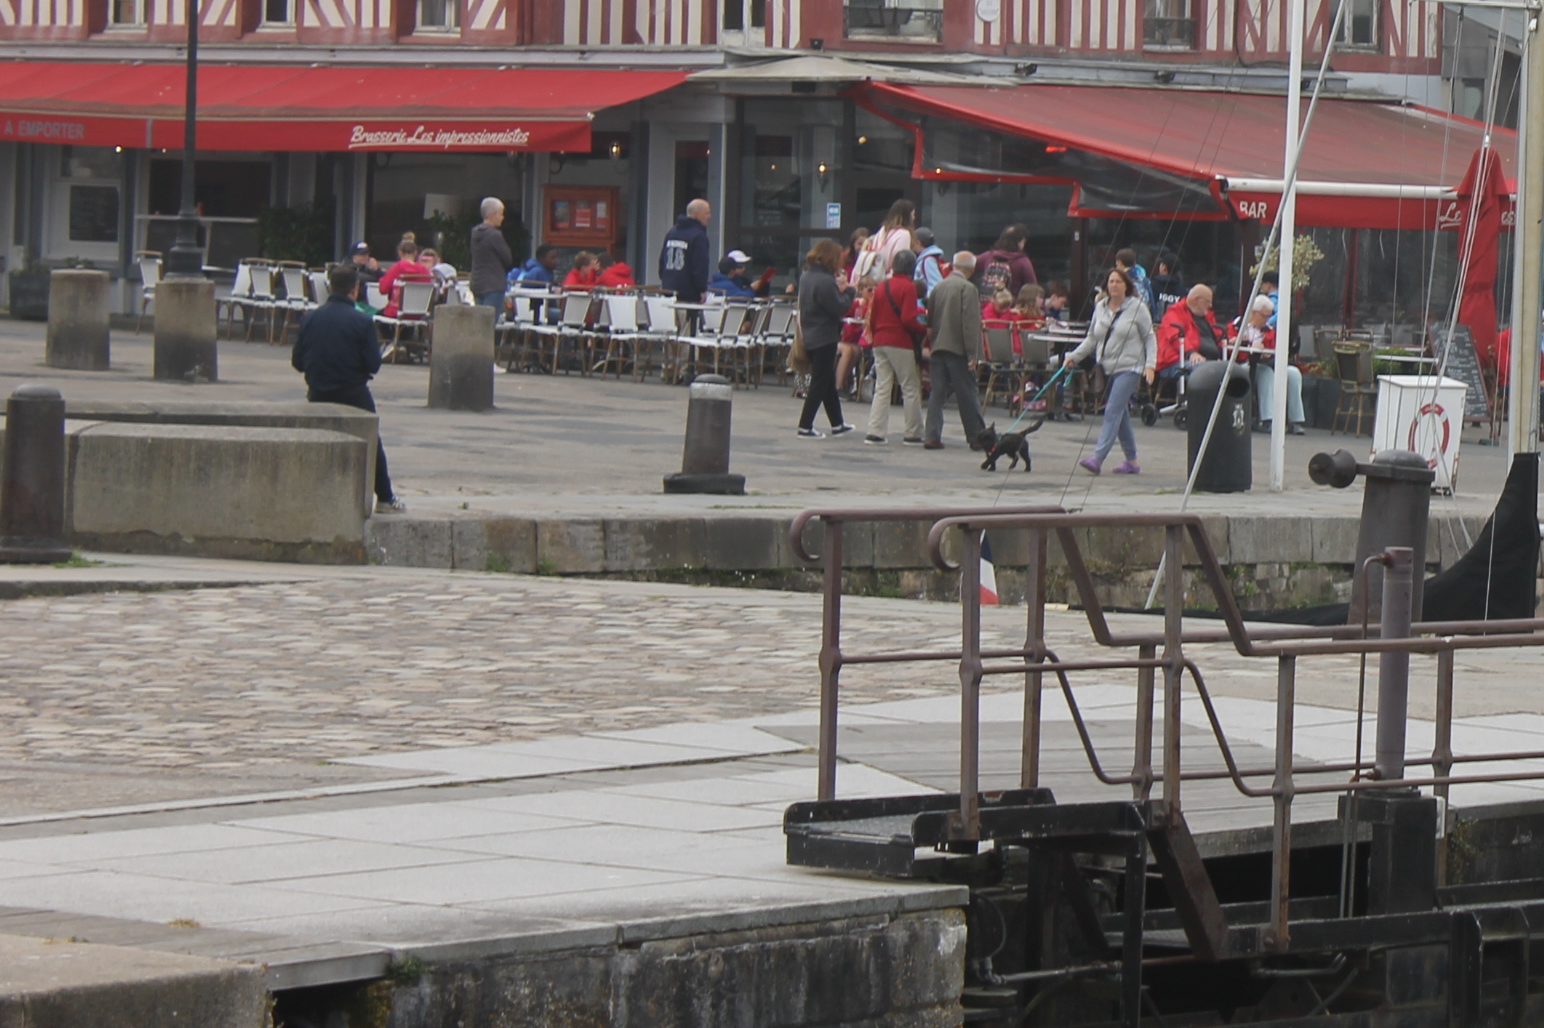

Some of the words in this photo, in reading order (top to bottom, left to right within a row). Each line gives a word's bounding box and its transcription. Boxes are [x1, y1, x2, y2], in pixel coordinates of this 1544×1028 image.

[4, 120, 13, 135] A
[18, 120, 84, 139] EMPORTER
[350, 125, 407, 144] Brasserie
[407, 125, 434, 143] Les
[435, 128, 530, 149] impressionnistes
[1239, 201, 1267, 218] BAR
